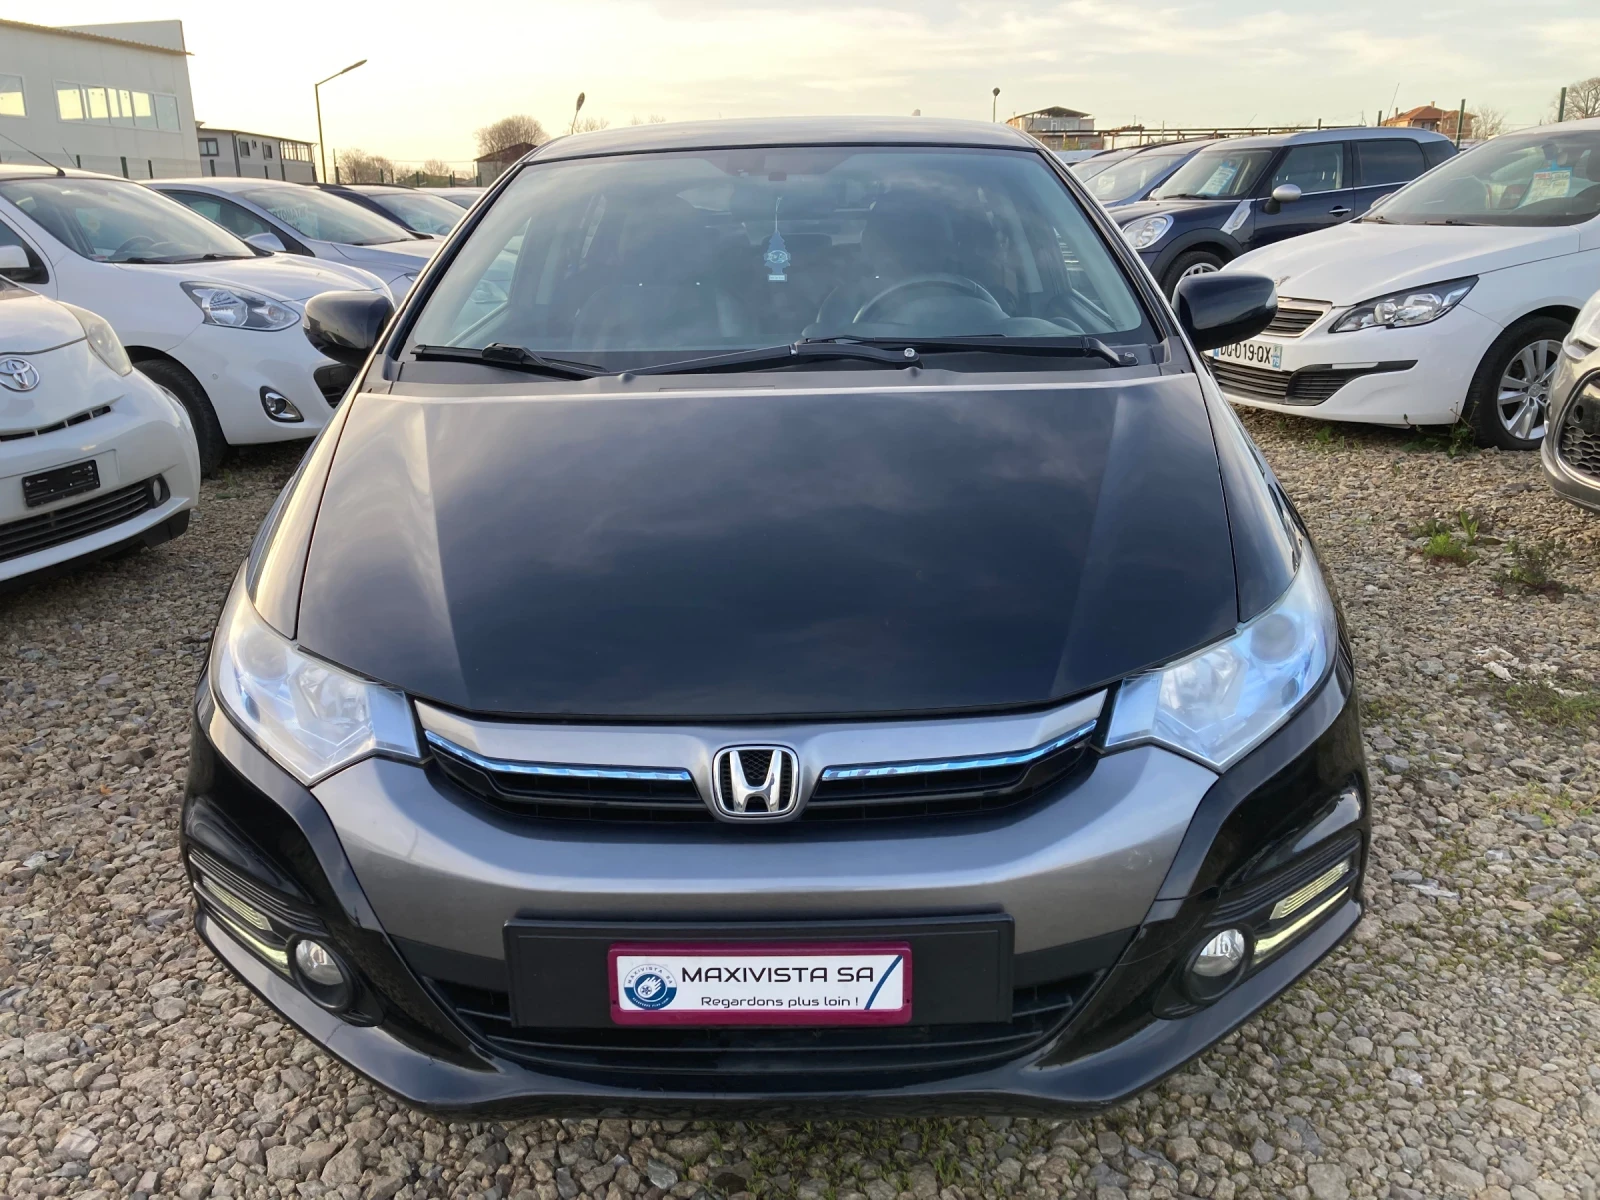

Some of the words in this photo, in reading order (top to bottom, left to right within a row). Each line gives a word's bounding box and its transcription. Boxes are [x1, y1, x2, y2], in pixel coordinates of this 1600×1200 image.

[682, 967, 828, 982] MAXIVISTA
[837, 967, 874, 982] SA
[701, 996, 784, 1008] Regardons
[788, 996, 820, 1008] plus
[824, 996, 851, 1006] loin
